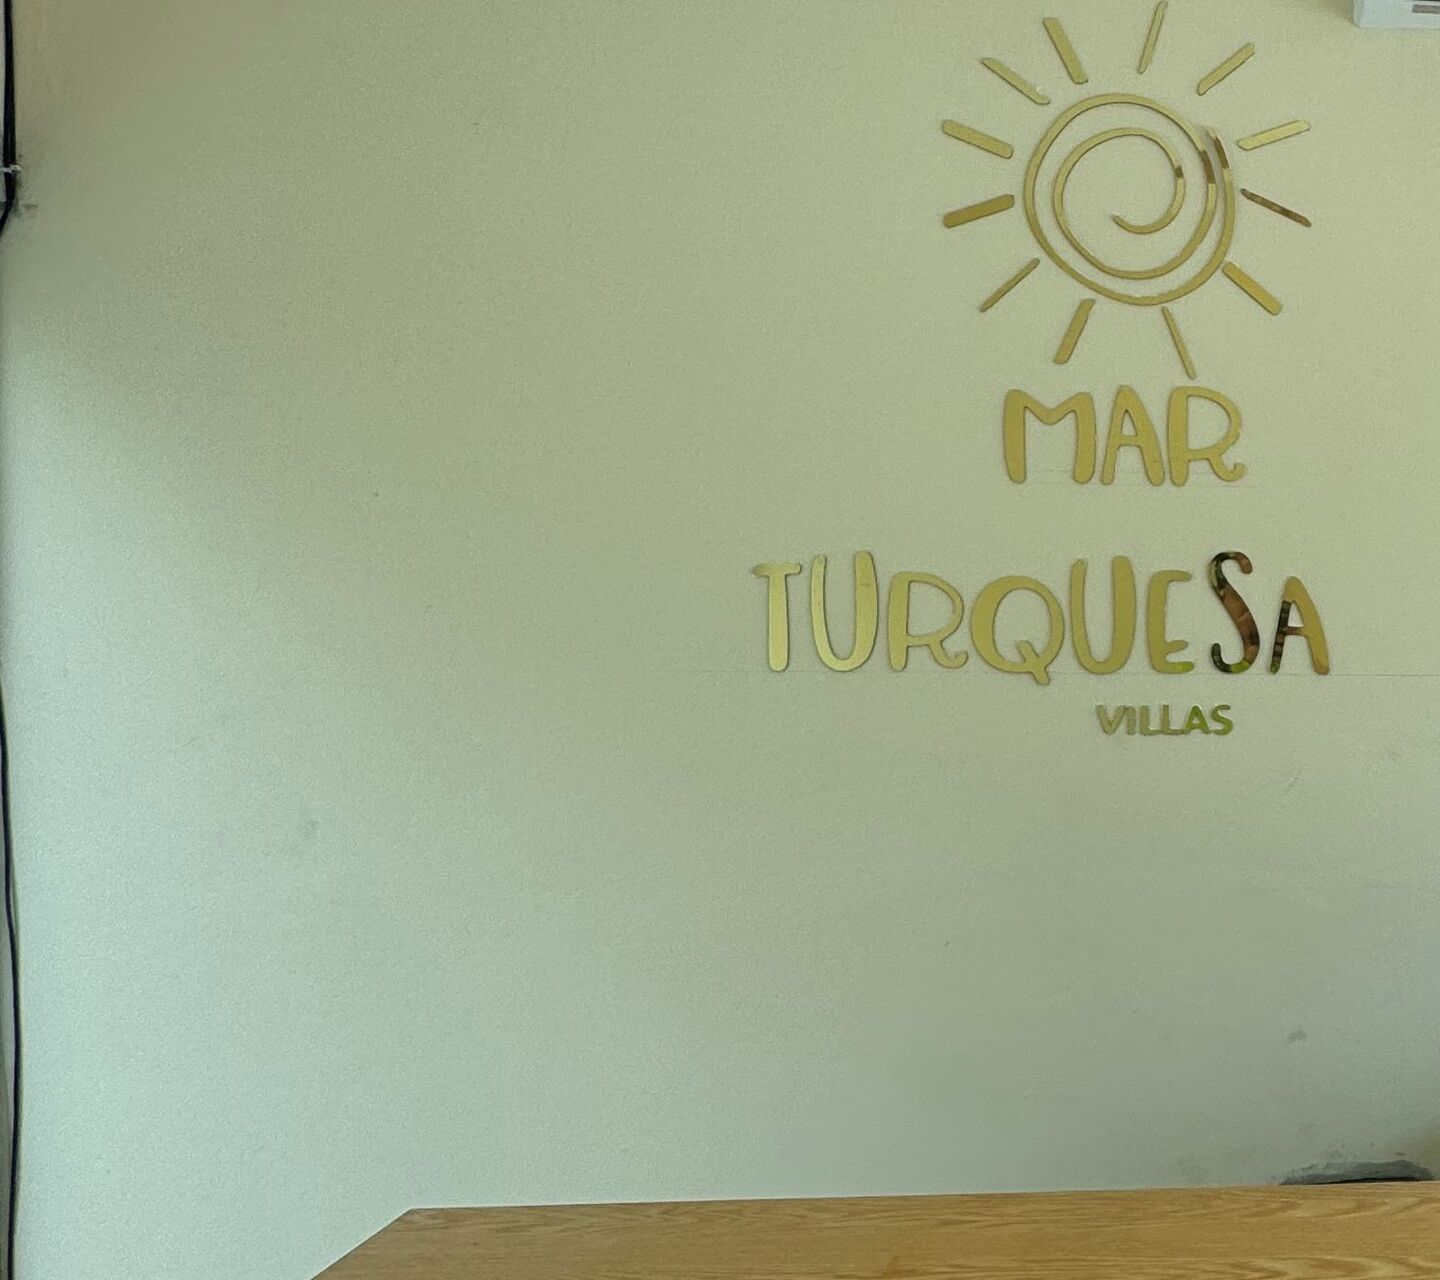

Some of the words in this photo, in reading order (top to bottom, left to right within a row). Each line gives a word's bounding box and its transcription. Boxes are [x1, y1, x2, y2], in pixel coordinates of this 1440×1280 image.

[1003, 385, 1246, 486] MAR
[752, 550, 1330, 685] TURQUESA
[1095, 704, 1234, 736] VILLAS
